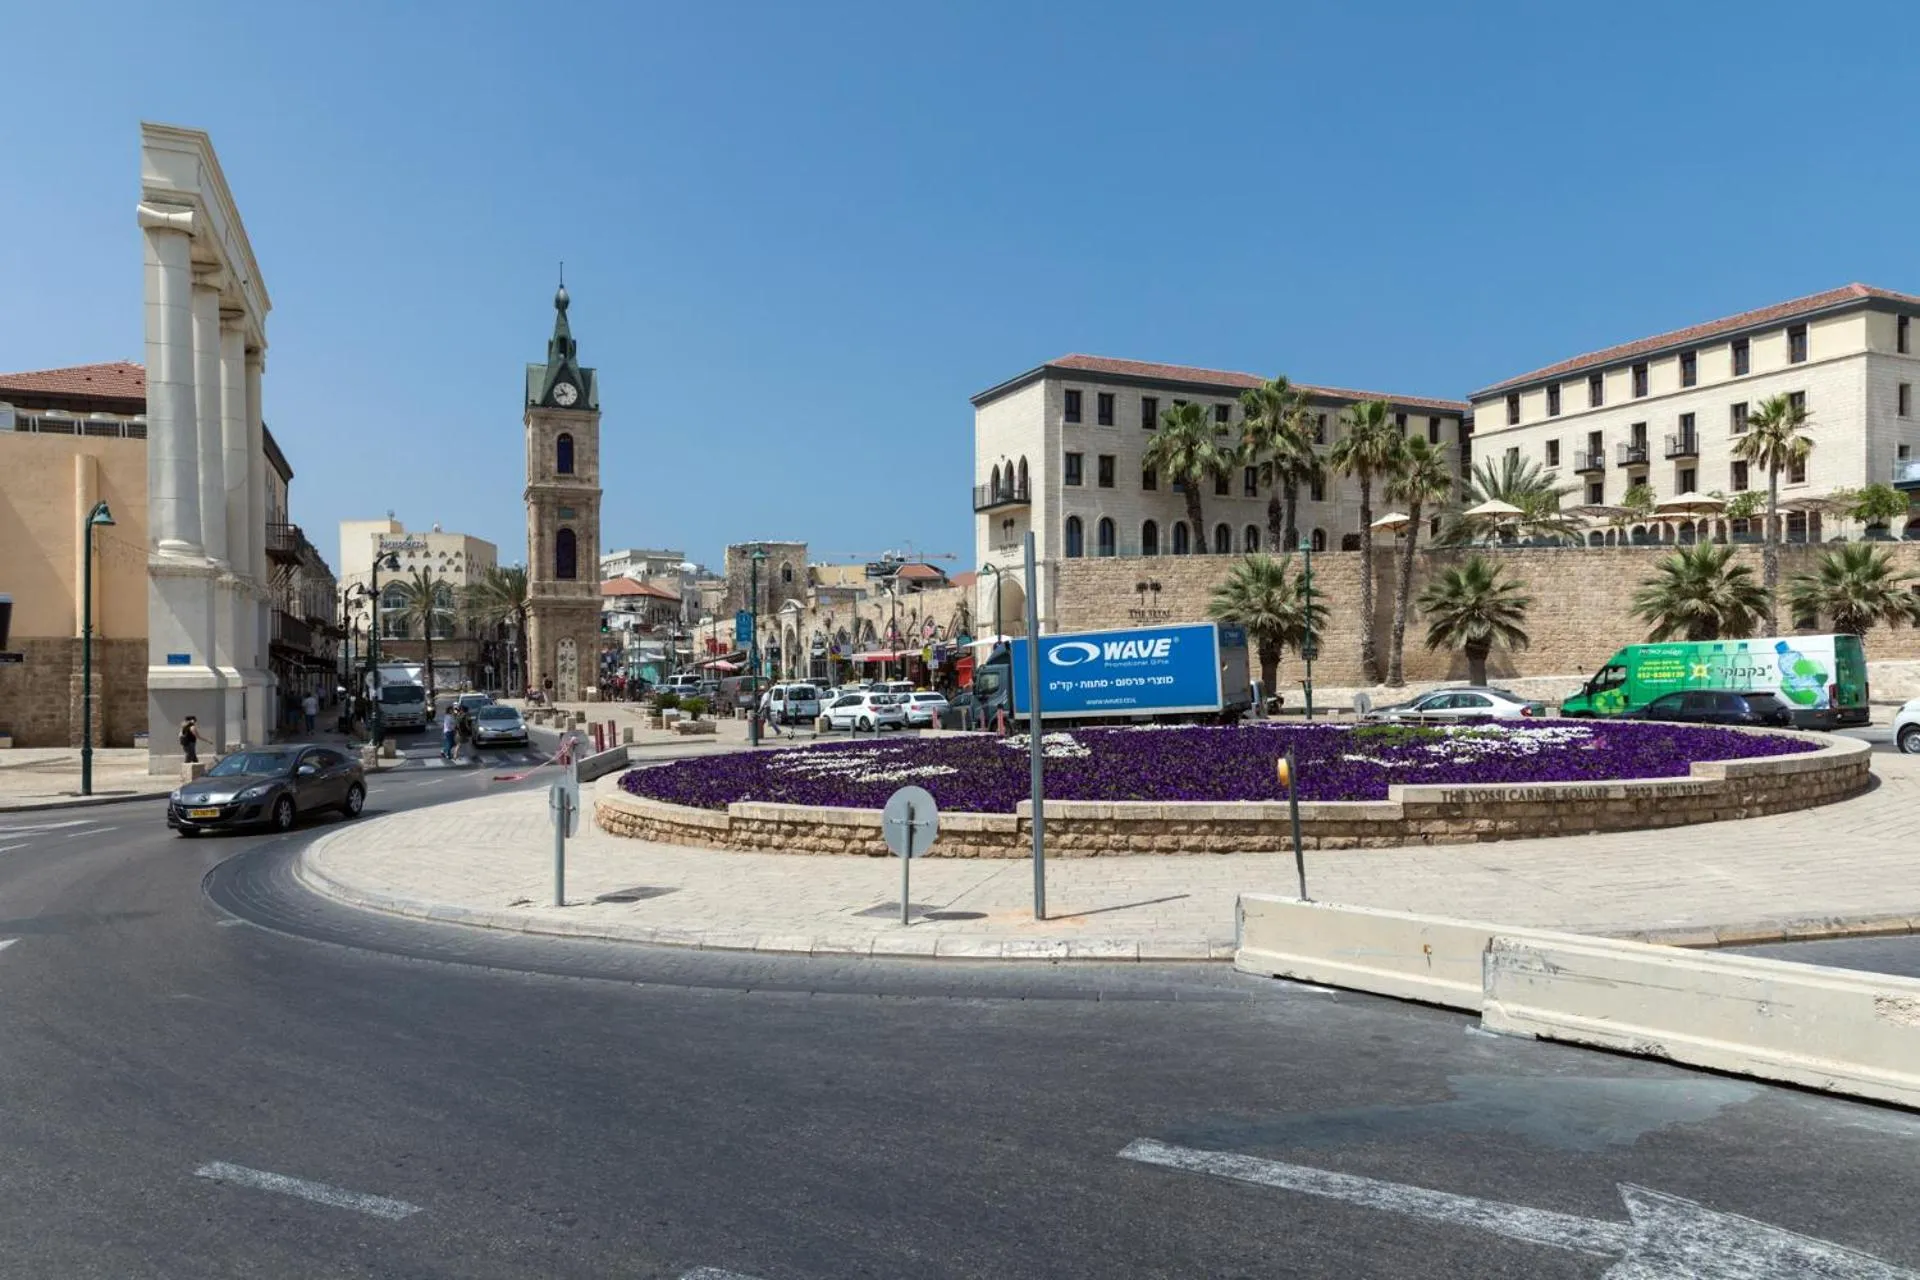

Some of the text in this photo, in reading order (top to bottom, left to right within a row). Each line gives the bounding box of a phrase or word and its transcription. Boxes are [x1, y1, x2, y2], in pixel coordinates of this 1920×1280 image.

[1102, 638, 1172, 661] WAVE
[1115, 677, 1145, 687] פרסום
[1441, 789, 1465, 802] THE
[1467, 788, 1506, 802] YOSSI
[1561, 784, 1609, 800] SQUARE
